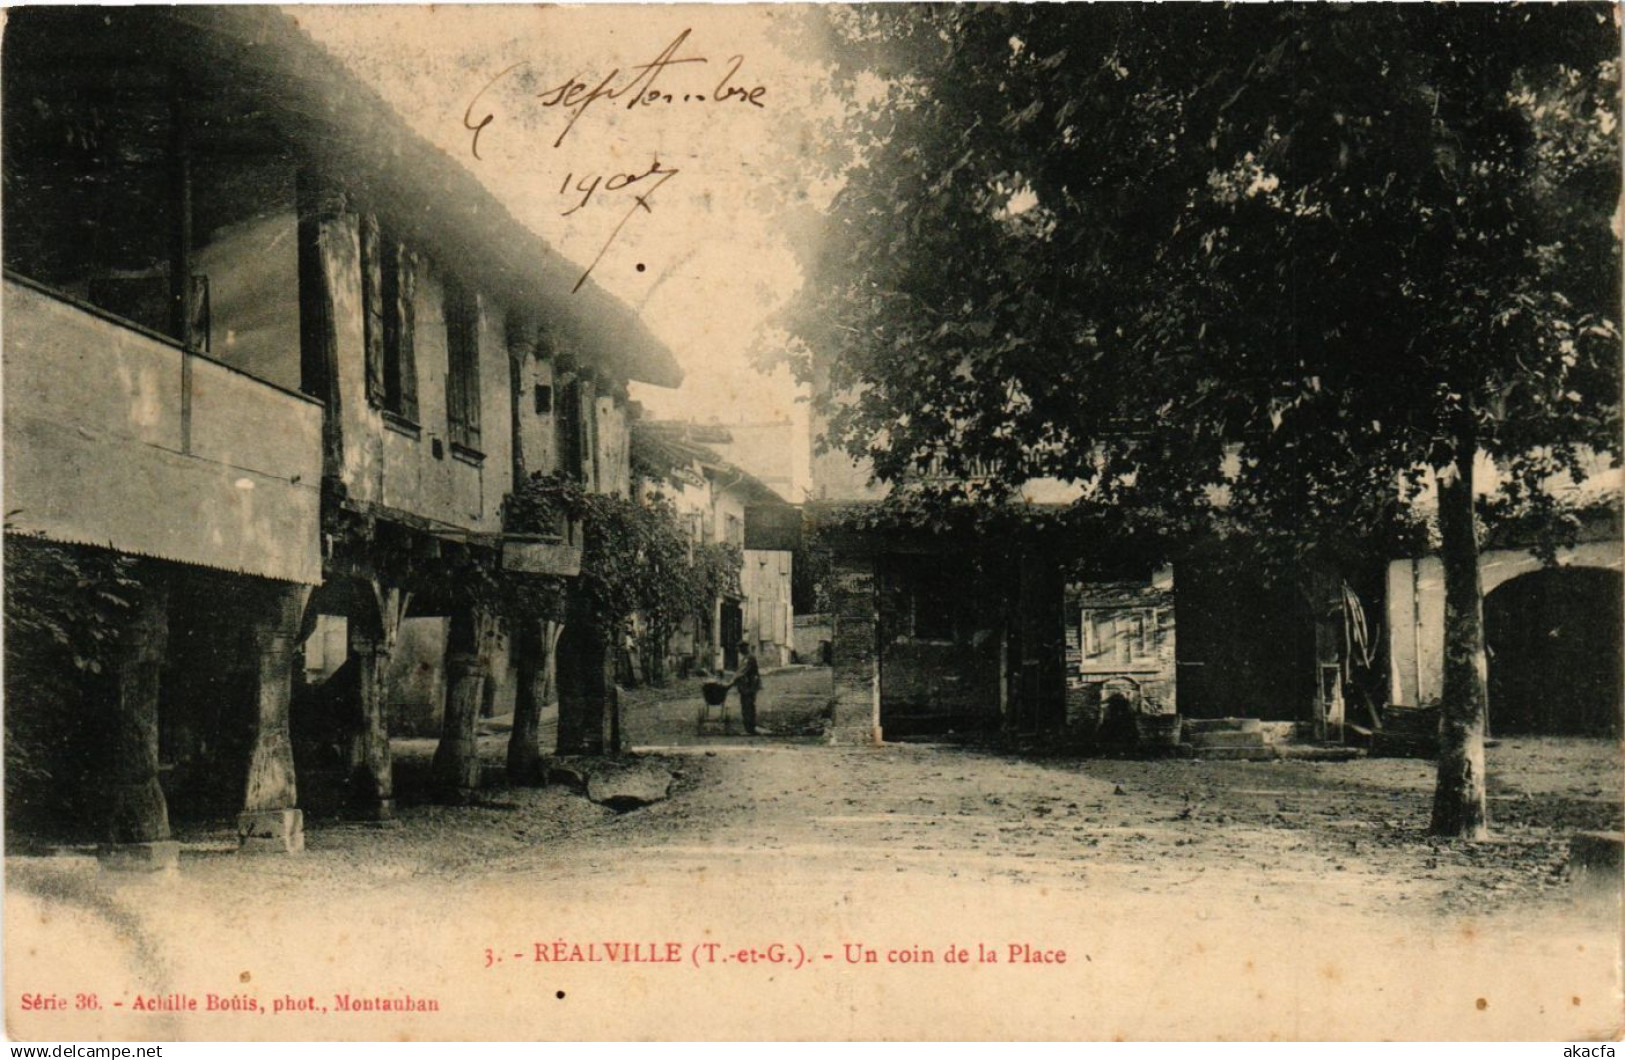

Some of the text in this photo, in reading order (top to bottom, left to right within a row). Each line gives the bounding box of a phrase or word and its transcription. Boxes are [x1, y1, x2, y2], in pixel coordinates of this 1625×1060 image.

[485, 949, 501, 968] 3.
[534, 938, 683, 964] RÉALVILLE
[844, 943, 878, 964] Un
[887, 943, 934, 964] coin
[942, 943, 969, 964] de
[978, 943, 997, 964] la
[1007, 942, 1066, 964] Place
[20, 993, 67, 1011] Série
[75, 993, 103, 1011] 36.
[132, 993, 197, 1011] Achille
[273, 993, 327, 1015] phot.,
[334, 993, 439, 1012] Montauban
